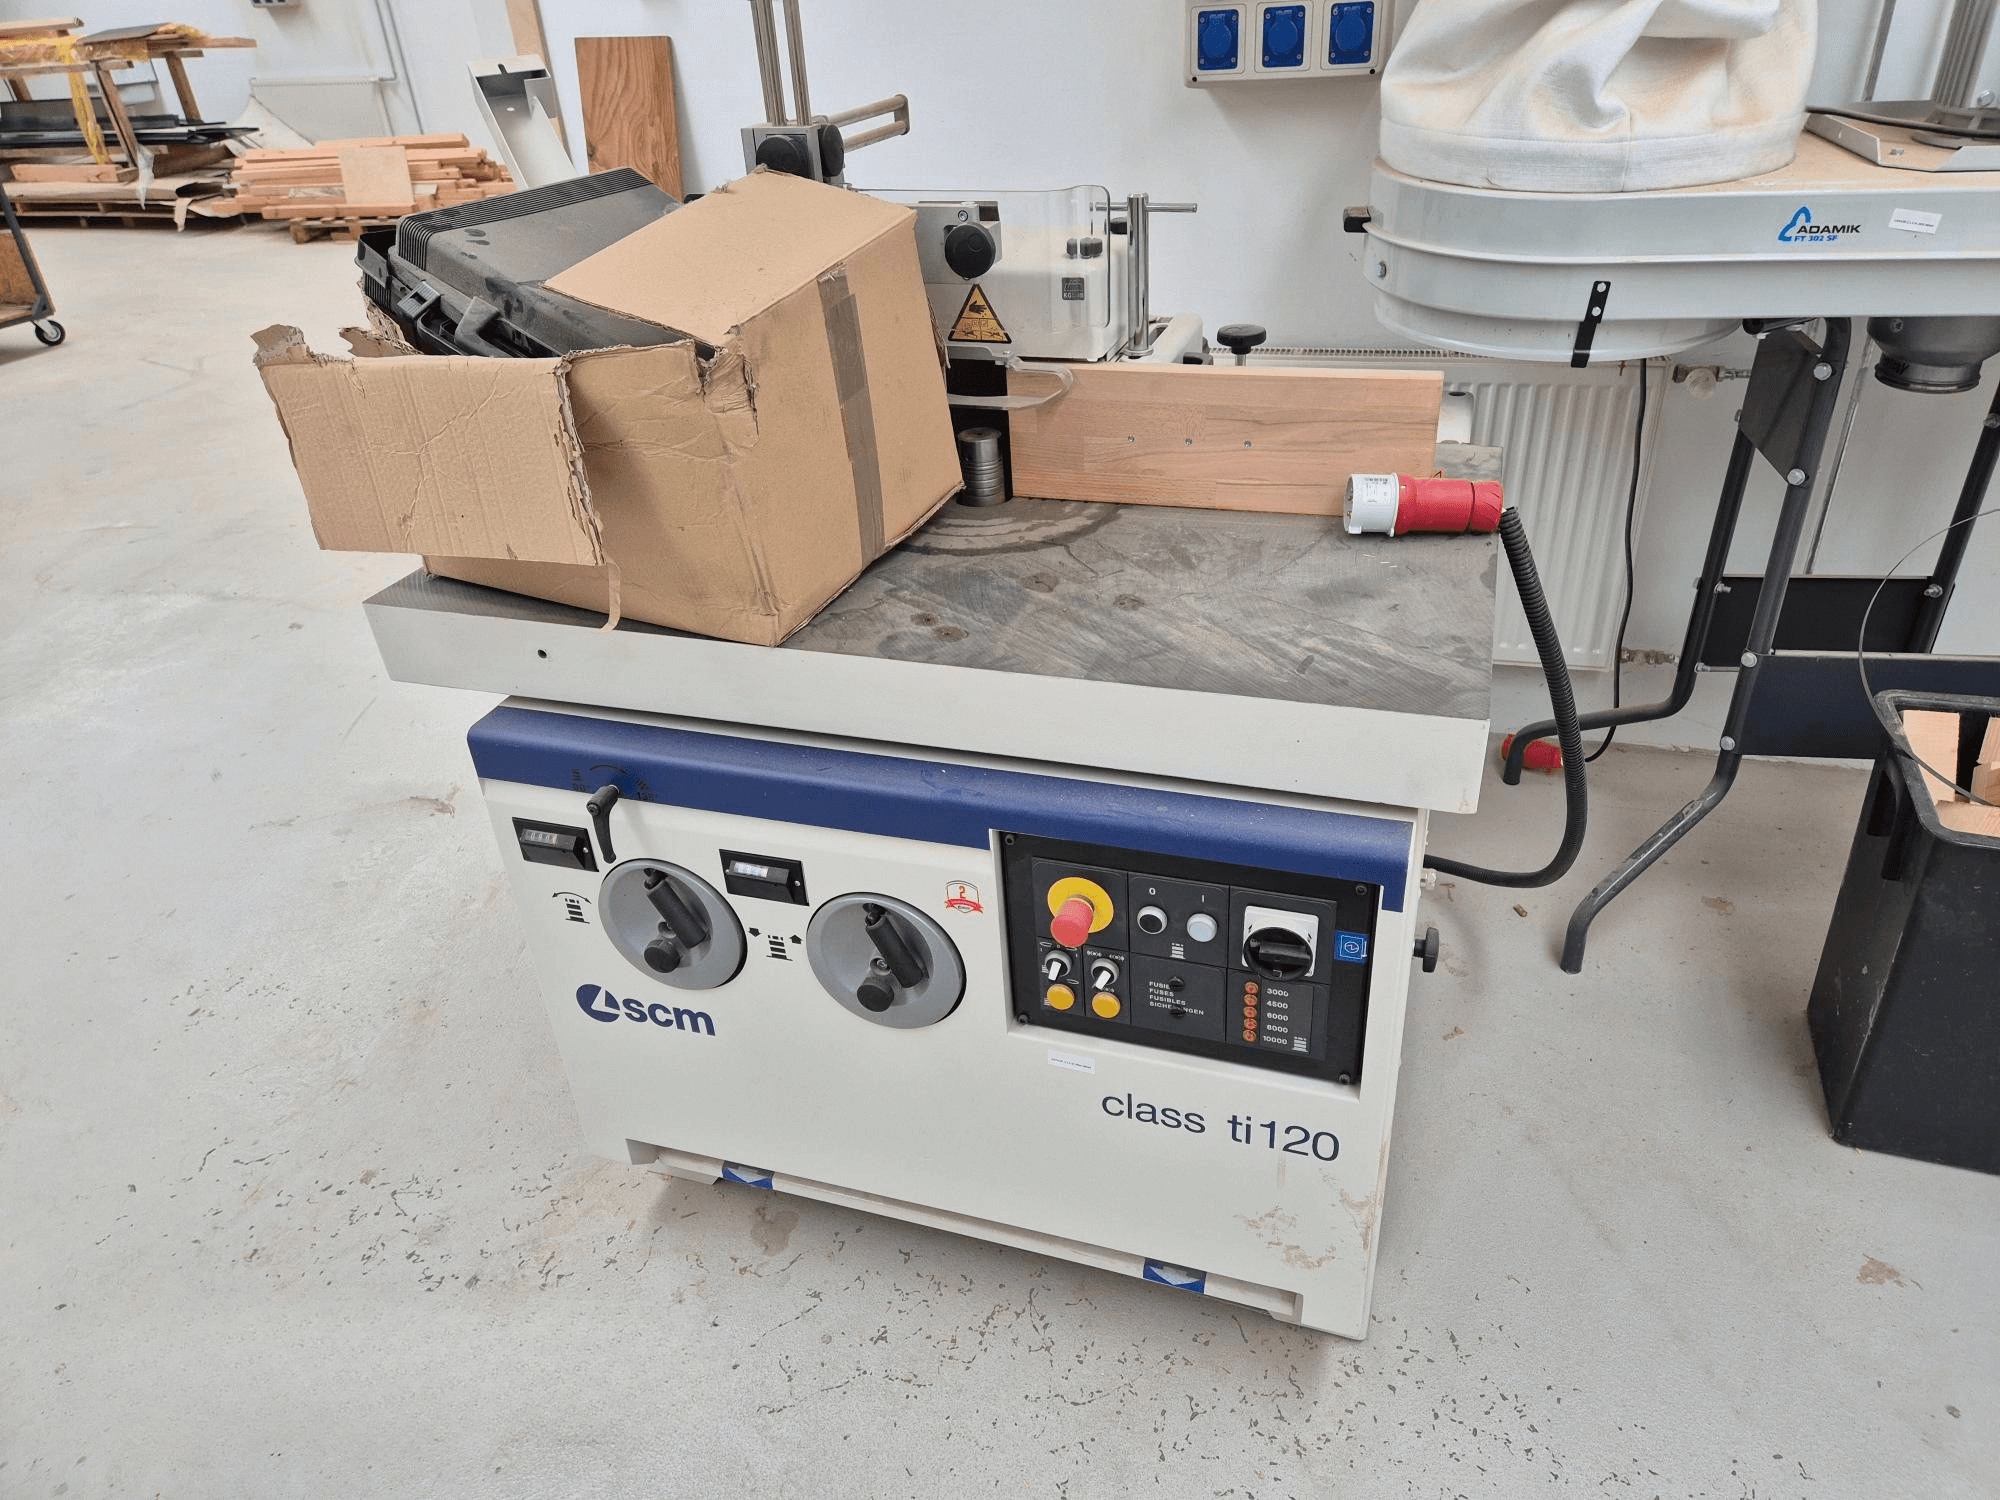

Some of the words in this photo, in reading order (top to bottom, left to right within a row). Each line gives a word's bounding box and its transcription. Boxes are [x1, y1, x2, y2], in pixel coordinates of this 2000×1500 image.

[1796, 225, 1861, 234] ADAMIK
[1149, 988, 1175, 997] FUSES
[1266, 988, 1289, 997] 3000
[1149, 994, 1186, 1006] FUSIBLES
[1266, 1000, 1288, 1009] 4500
[622, 998, 715, 1036] scm
[1263, 1035, 1288, 1045] 10000
[1101, 1093, 1206, 1134] class
